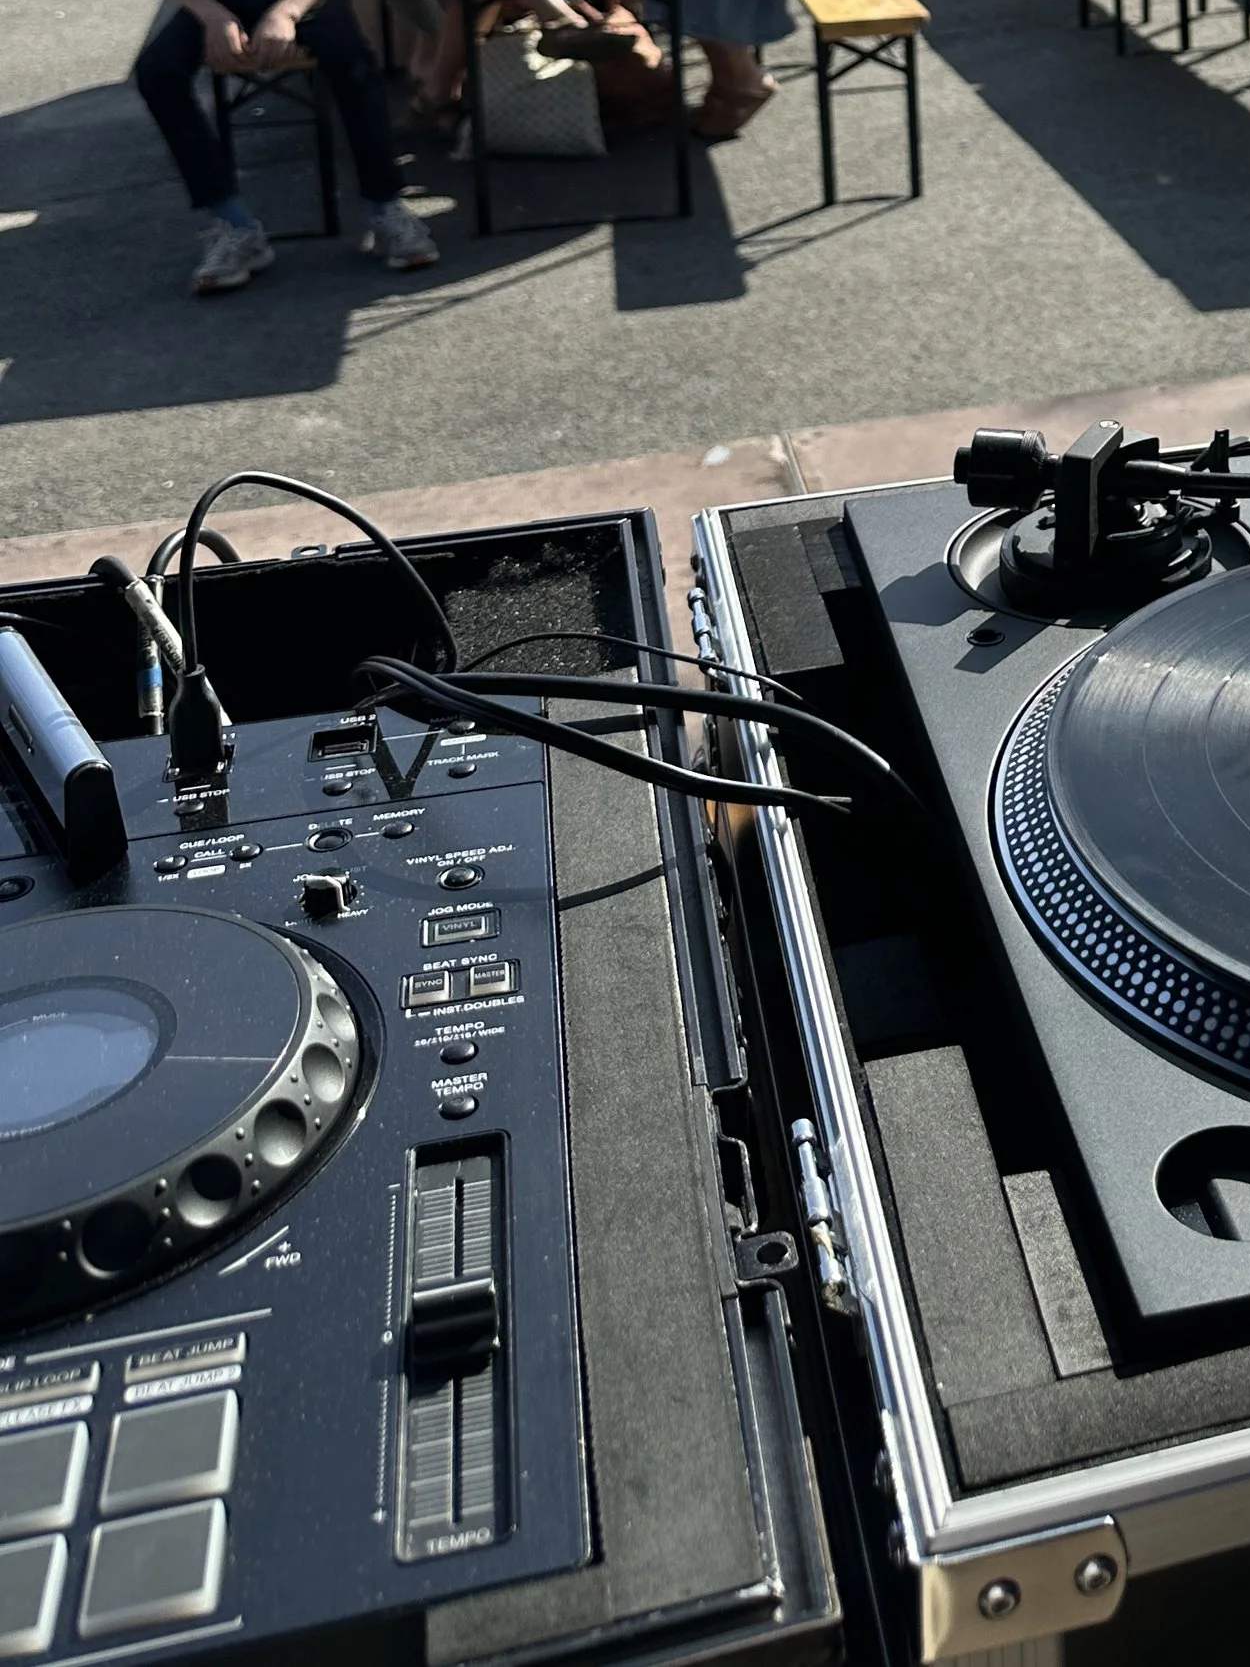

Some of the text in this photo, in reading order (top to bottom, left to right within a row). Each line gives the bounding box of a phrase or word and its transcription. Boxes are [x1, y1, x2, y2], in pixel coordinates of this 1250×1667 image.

[427, 751, 499, 766] TRACK MARK
[345, 768, 376, 777] STOP
[172, 788, 231, 803] USB STOP
[372, 807, 426, 821] MEMORY
[179, 834, 245, 850] CUE/LOOP
[194, 848, 226, 859] CALL
[406, 853, 443, 866] VINYL
[445, 848, 486, 860] SPEED
[337, 909, 369, 919] HEAVY
[427, 901, 494, 916] JOG MODE
[442, 920, 478, 931] VINYL
[423, 953, 498, 971] BEAT SYNC
[474, 969, 506, 980] MASTER
[414, 978, 443, 988] SYNC
[435, 1021, 486, 1036] TEMPO
[431, 1072, 489, 1090] MASTER
[435, 1081, 485, 1098] TEMPO
[264, 1252, 302, 1270] FWD
[138, 1337, 234, 1367] BEAT JUMP
[34, 1368, 82, 1387] LOOP
[426, 1527, 491, 1554] TEMPO
